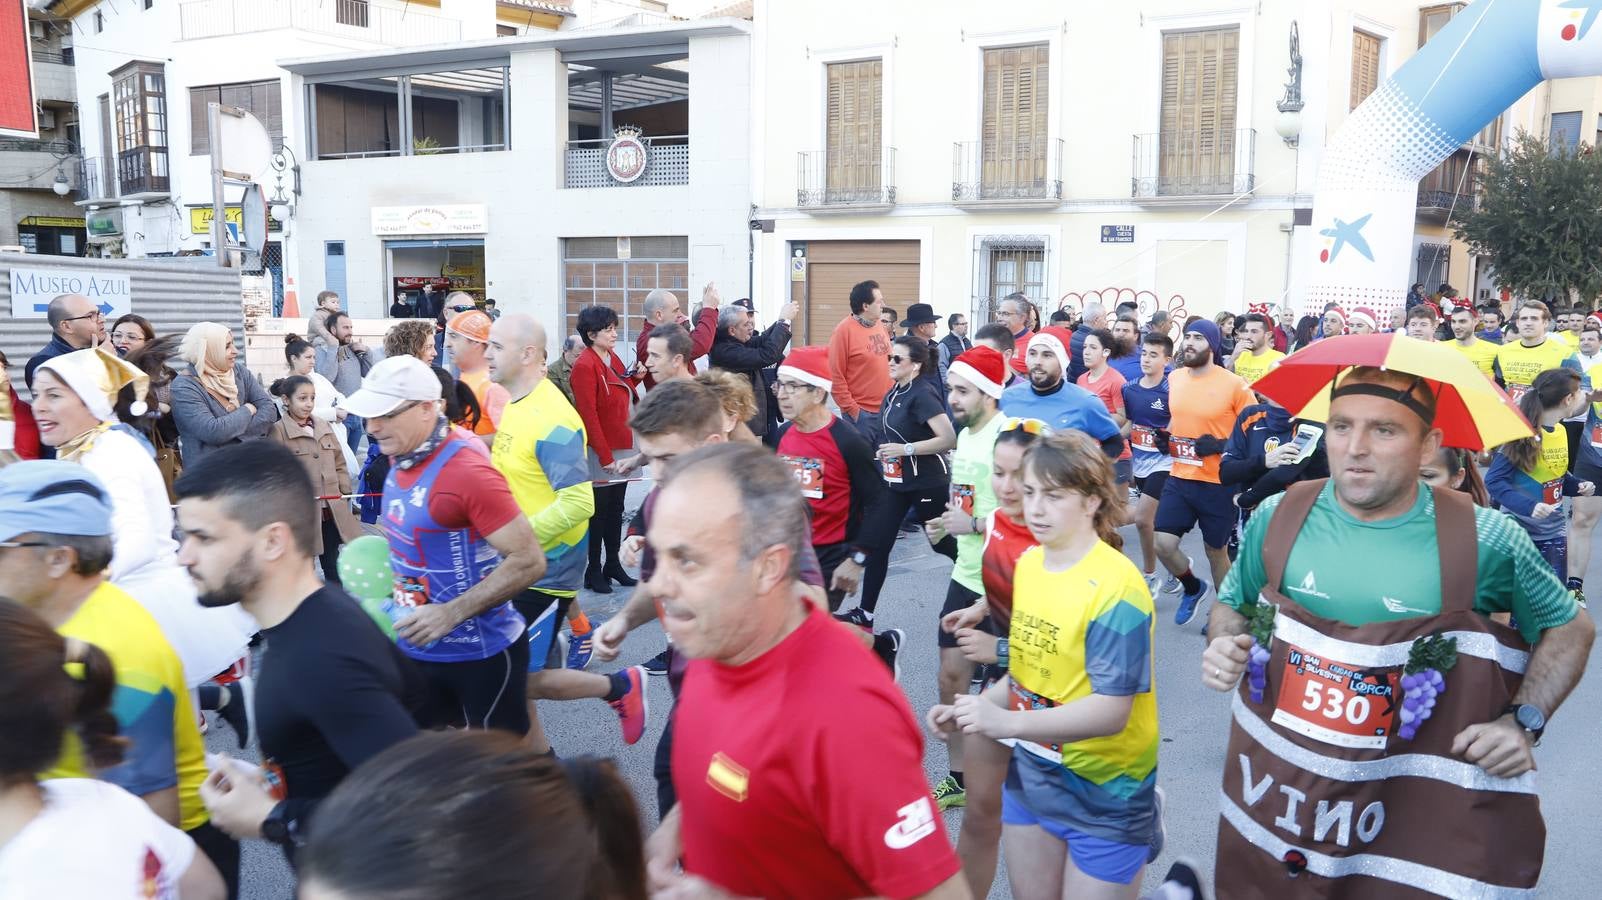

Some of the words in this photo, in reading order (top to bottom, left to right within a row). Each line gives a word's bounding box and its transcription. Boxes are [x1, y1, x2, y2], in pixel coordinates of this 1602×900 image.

[1176, 444, 1196, 457] 154
[448, 531, 466, 580] ATLETISMO
[1289, 651, 1302, 665] VI
[1303, 654, 1321, 666] SAN
[1329, 664, 1354, 678] CIUDAD
[1353, 672, 1364, 681] DE
[1305, 663, 1343, 683] SILVESTRE
[1349, 680, 1392, 696] LORCA
[1301, 679, 1371, 725] 530
[1238, 753, 1386, 848] VINO
